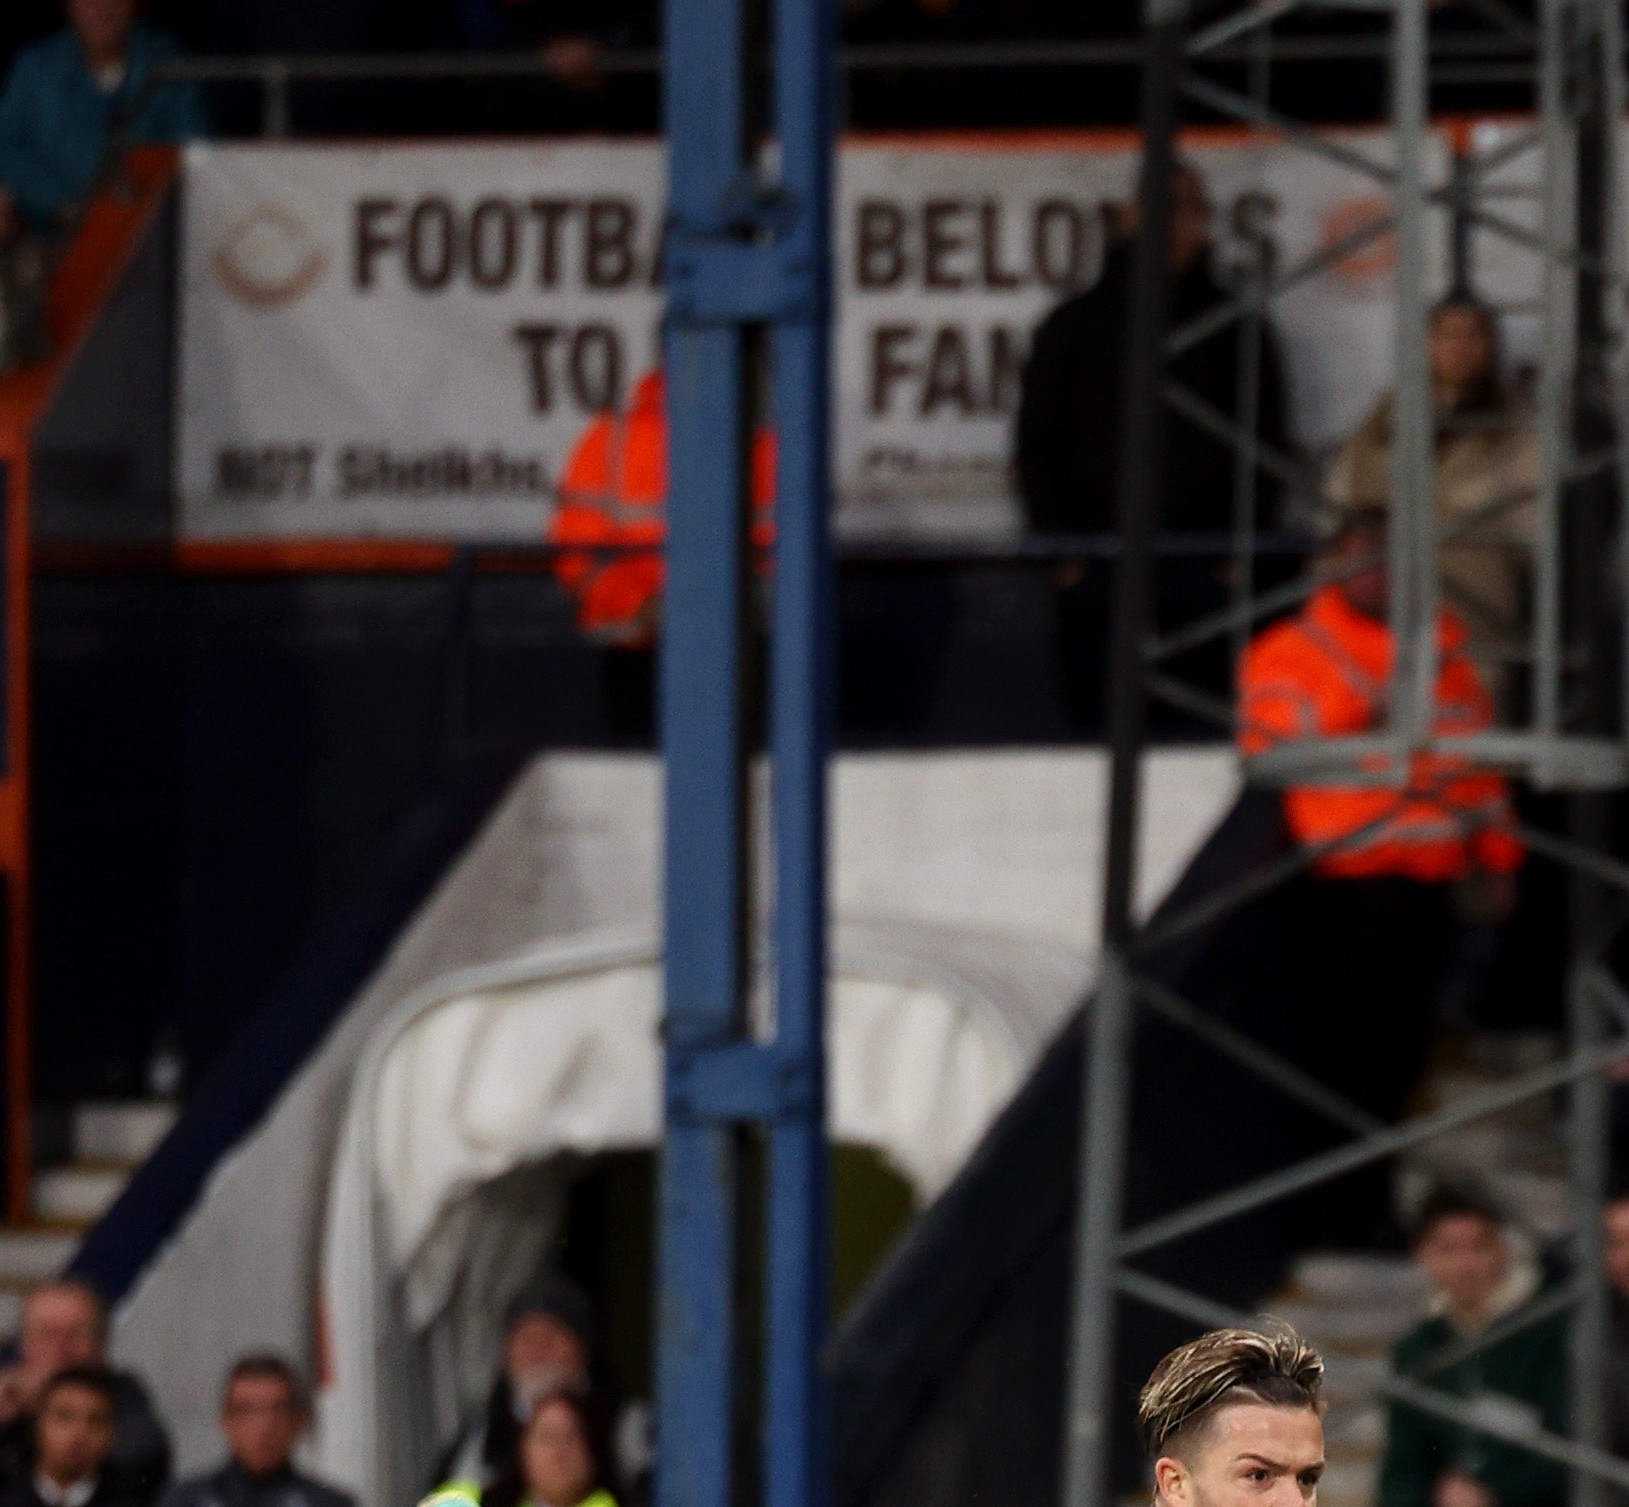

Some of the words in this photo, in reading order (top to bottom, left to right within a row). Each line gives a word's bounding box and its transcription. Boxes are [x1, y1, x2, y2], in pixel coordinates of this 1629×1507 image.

[350, 193, 667, 293] FOOTB
[853, 188, 1279, 293] BELOS
[513, 319, 624, 418] TO
